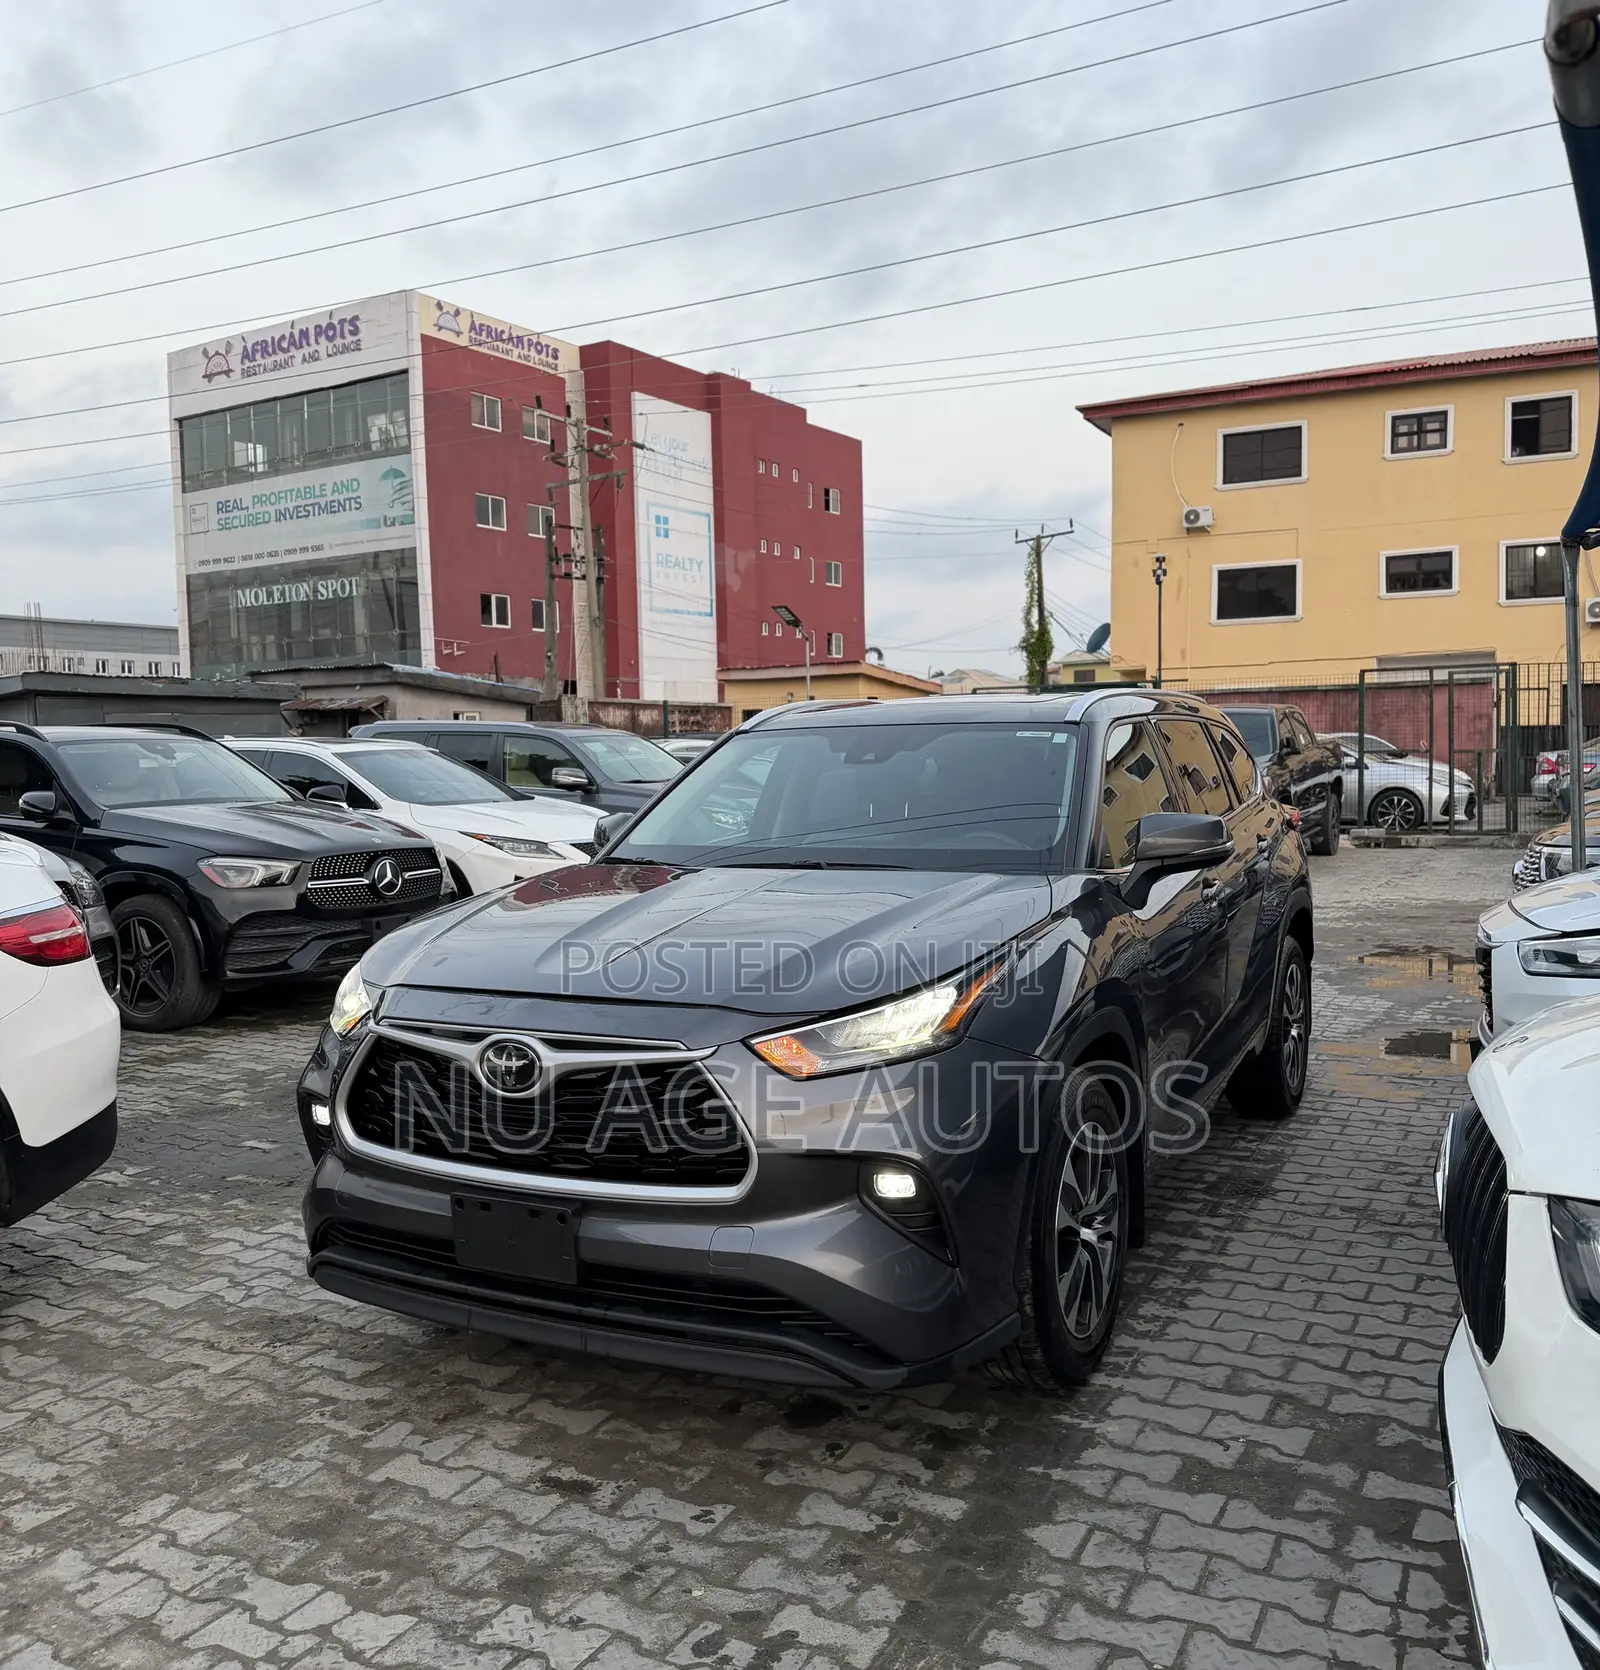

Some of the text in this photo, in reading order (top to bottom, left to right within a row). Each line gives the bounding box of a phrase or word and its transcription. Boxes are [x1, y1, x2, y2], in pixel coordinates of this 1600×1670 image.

[240, 338, 362, 379] RESTAURANT AND LOUNGE
[517, 352, 532, 363] AND
[216, 477, 361, 516] REAL, PROFITABLE AND
[217, 495, 363, 532] SECURED INVESTMENTS
[656, 551, 704, 574] REALTY
[236, 576, 360, 608] MOLETON SPOT
